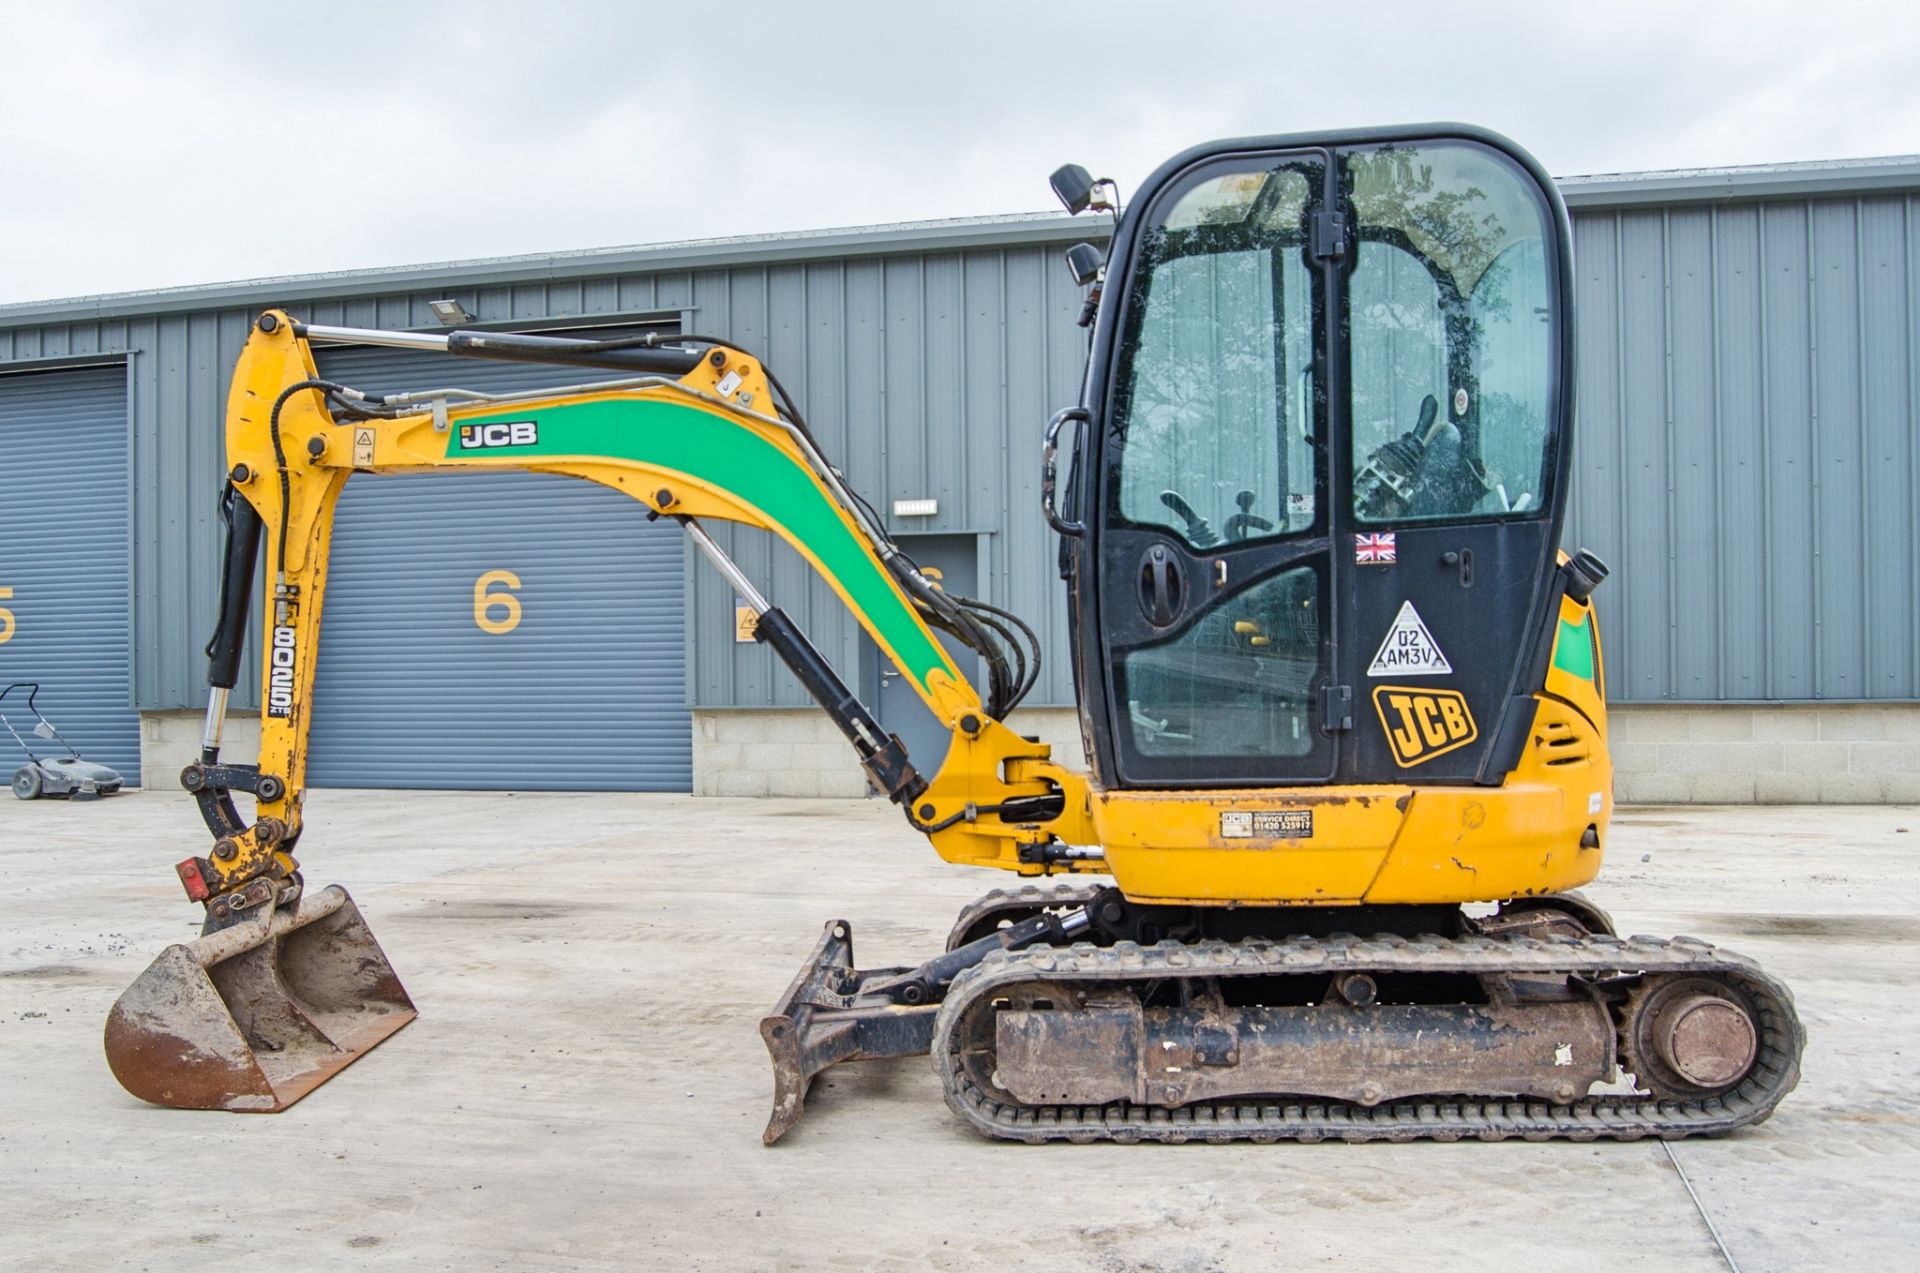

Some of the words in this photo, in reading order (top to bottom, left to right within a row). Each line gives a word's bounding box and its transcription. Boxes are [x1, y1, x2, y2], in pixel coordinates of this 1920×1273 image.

[461, 422, 537, 448] JCB
[474, 570, 522, 634] 6
[270, 626, 295, 707] 8025
[1387, 648, 1432, 665] AM3V
[1389, 694, 1469, 759] JCB
